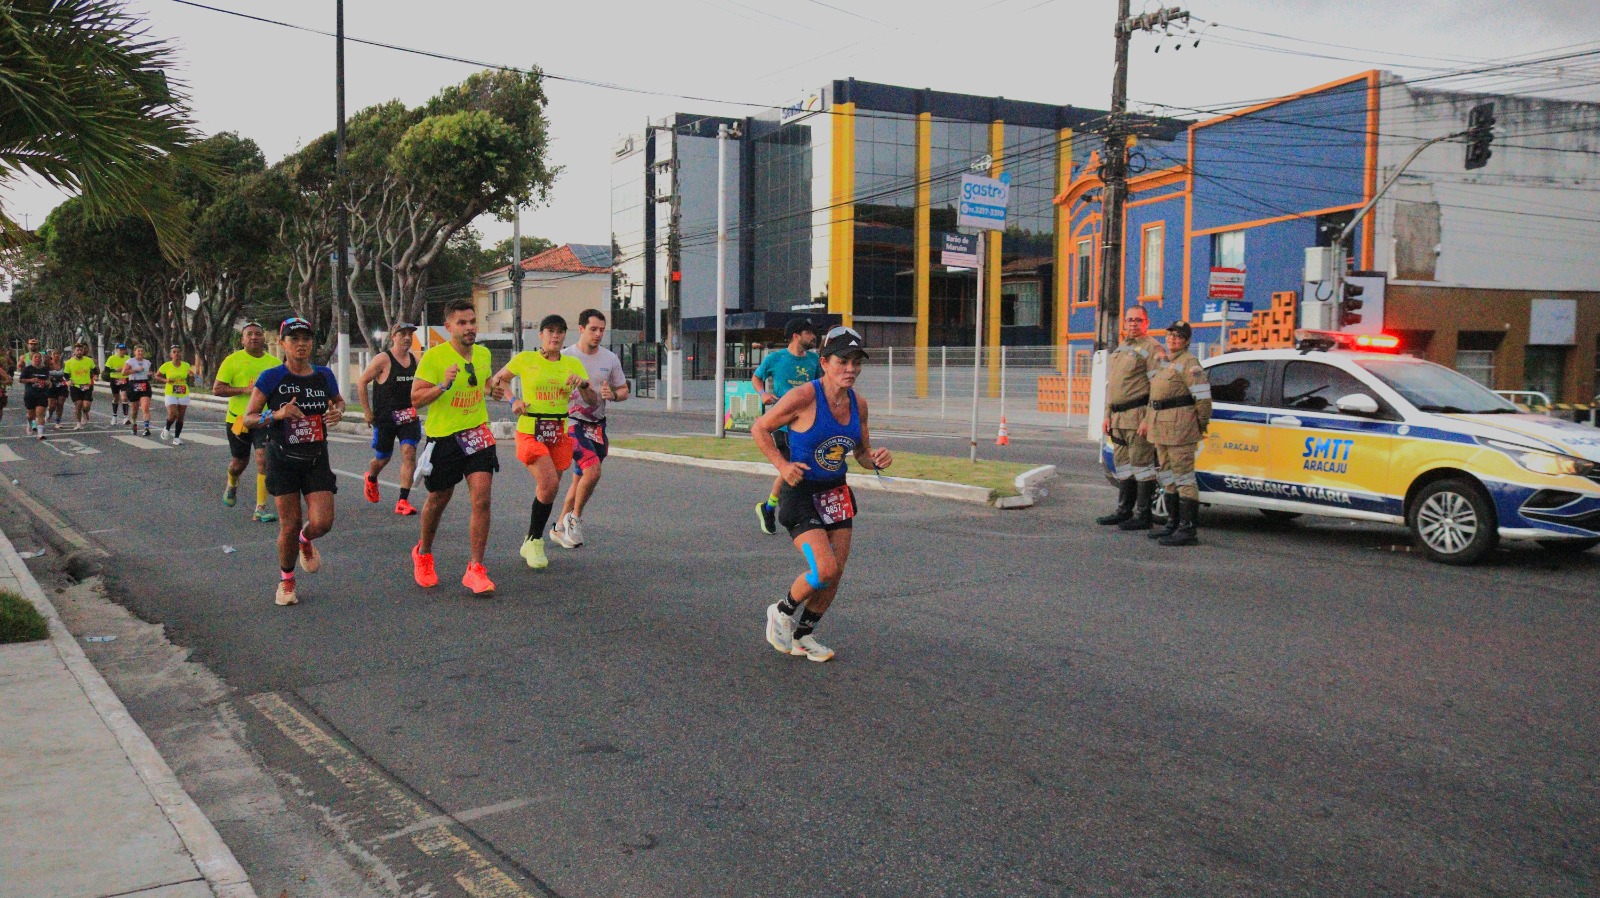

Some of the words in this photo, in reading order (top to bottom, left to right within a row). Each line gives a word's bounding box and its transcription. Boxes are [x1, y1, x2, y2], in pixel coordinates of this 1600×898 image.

[963, 182, 1006, 200] gastro
[962, 236, 969, 244] de
[279, 383, 301, 396] Cris
[306, 388, 326, 399] Run
[295, 427, 313, 437] 9892
[1223, 442, 1259, 453] ARACAJU
[1302, 436, 1354, 461] SMTT
[1302, 459, 1348, 474] ARACAJU
[1223, 477, 1301, 499] SEGURANÇA
[825, 502, 842, 515] 9857
